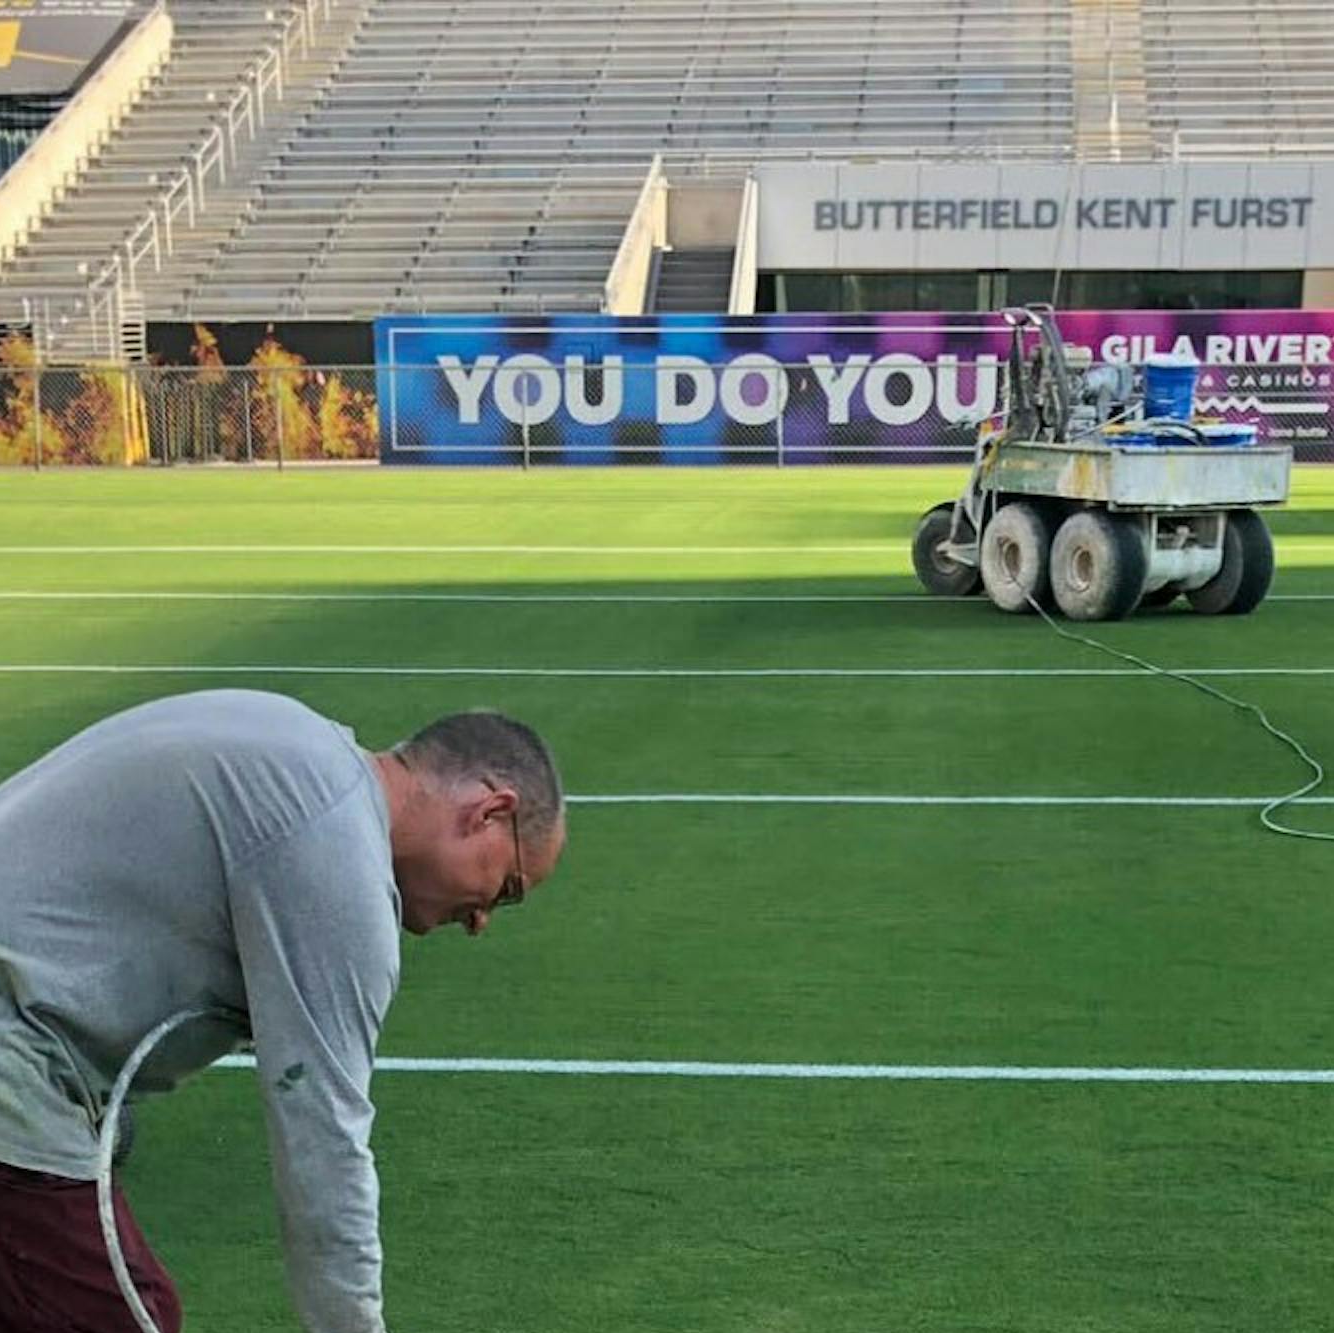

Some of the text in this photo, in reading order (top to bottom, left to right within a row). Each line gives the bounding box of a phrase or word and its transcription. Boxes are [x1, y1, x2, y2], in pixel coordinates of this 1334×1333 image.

[814, 198, 1314, 230] BUTTERFIELD KENT FURST
[1100, 334, 1333, 365] GILA RIVER
[436, 353, 999, 426] YOU DO YOU
[1226, 374, 1331, 388] CASINOS
